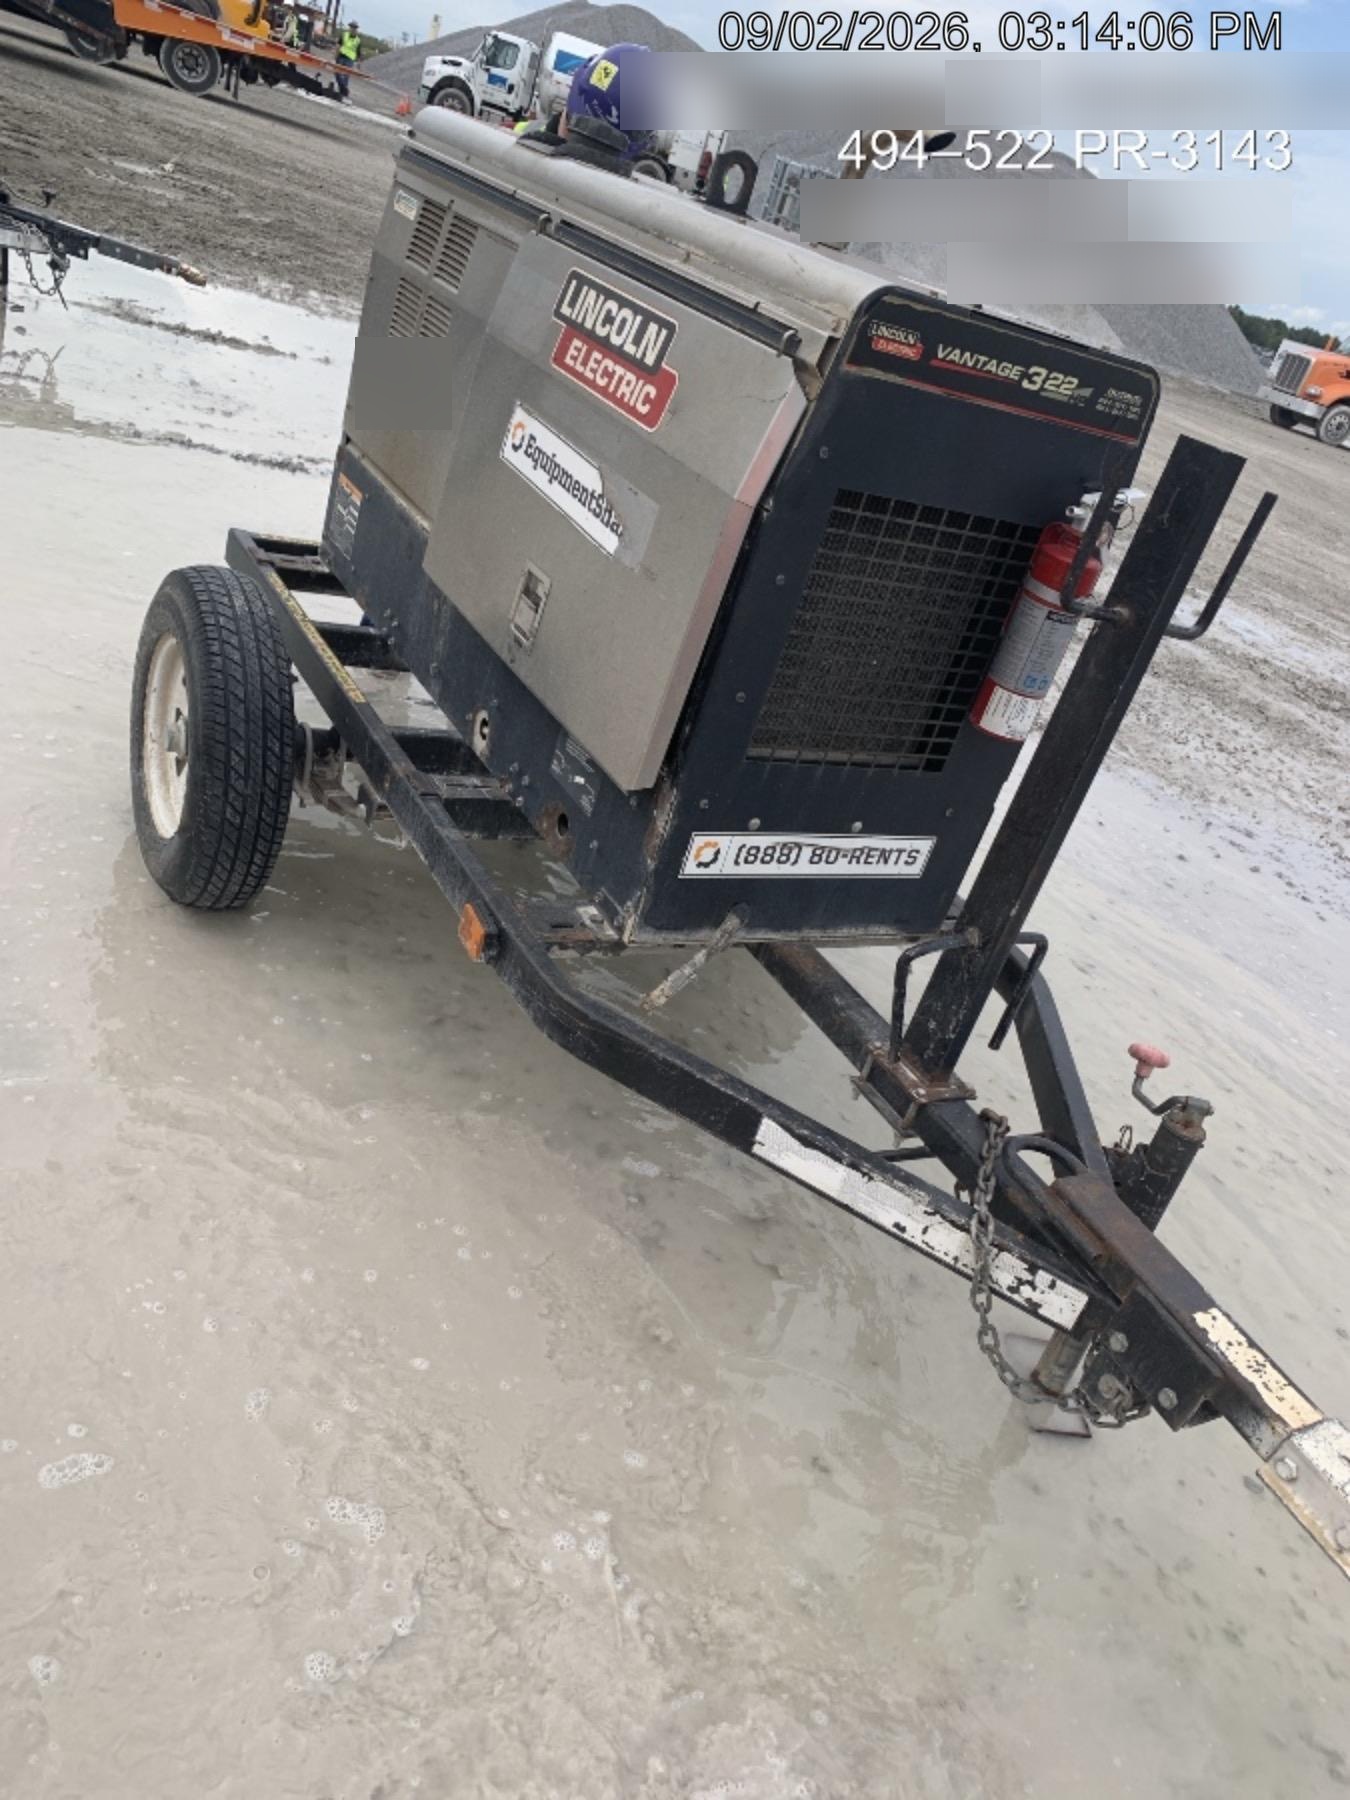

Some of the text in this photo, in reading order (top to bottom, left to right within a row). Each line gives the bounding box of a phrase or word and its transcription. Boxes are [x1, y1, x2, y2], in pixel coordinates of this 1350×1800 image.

[559, 279, 668, 367] LINCOLN
[564, 338, 657, 415] ELECTRIC
[936, 343, 1026, 381] VANTAGE
[1021, 365, 1079, 395] 322
[733, 843, 921, 867] (888) 80-RENTS
